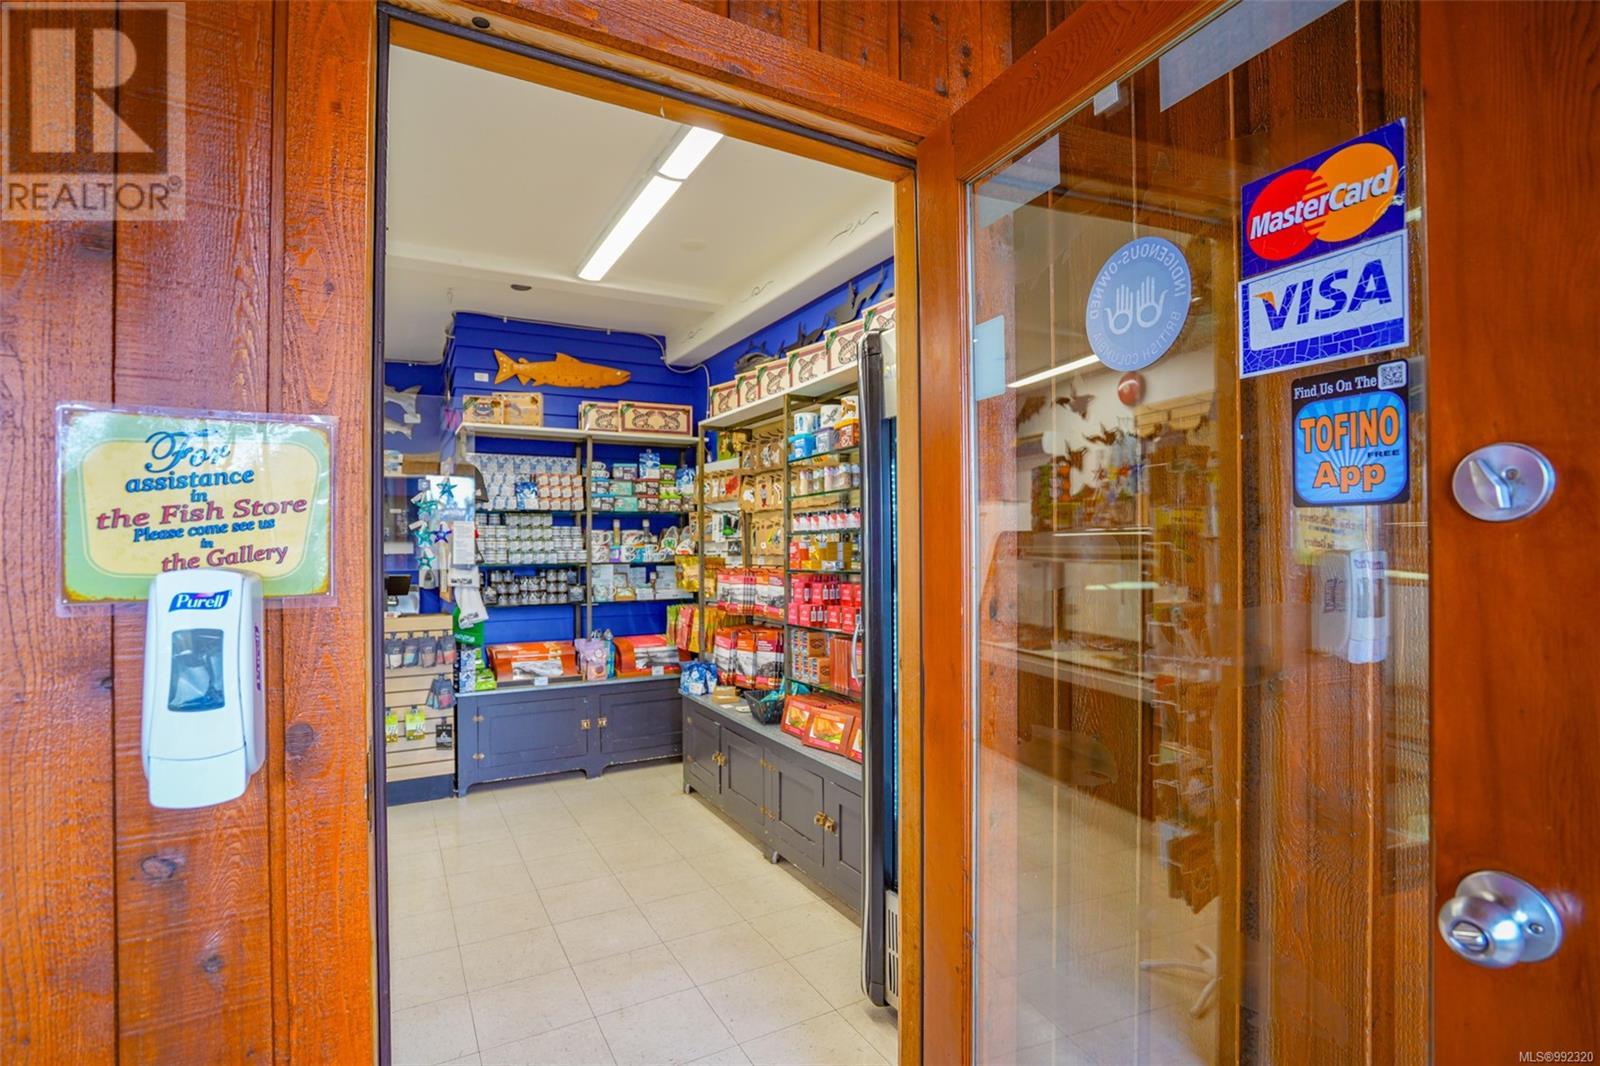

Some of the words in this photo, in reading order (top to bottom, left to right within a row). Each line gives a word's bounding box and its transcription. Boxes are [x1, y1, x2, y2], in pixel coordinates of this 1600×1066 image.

[1249, 164, 1394, 240] MasterCard
[1252, 258, 1392, 332] VISA
[1293, 385, 1317, 400] Find
[1319, 382, 1334, 395] Us
[1335, 379, 1353, 393] On
[1354, 375, 1378, 390] The
[1299, 405, 1400, 454] TOFINO
[144, 429, 231, 473] For
[1367, 449, 1401, 458] FREE
[125, 468, 255, 494] assistance
[1312, 461, 1386, 494] App
[190, 489, 208, 503] in
[96, 508, 150, 531] the
[159, 501, 225, 526] Fish
[233, 498, 308, 519] Store
[133, 525, 184, 543] Please
[187, 523, 229, 538] come
[231, 520, 255, 533] see
[258, 518, 275, 529] us
[200, 538, 214, 549] in
[161, 552, 200, 573] the
[206, 545, 289, 567] Gallery
[176, 593, 224, 609] Purell
